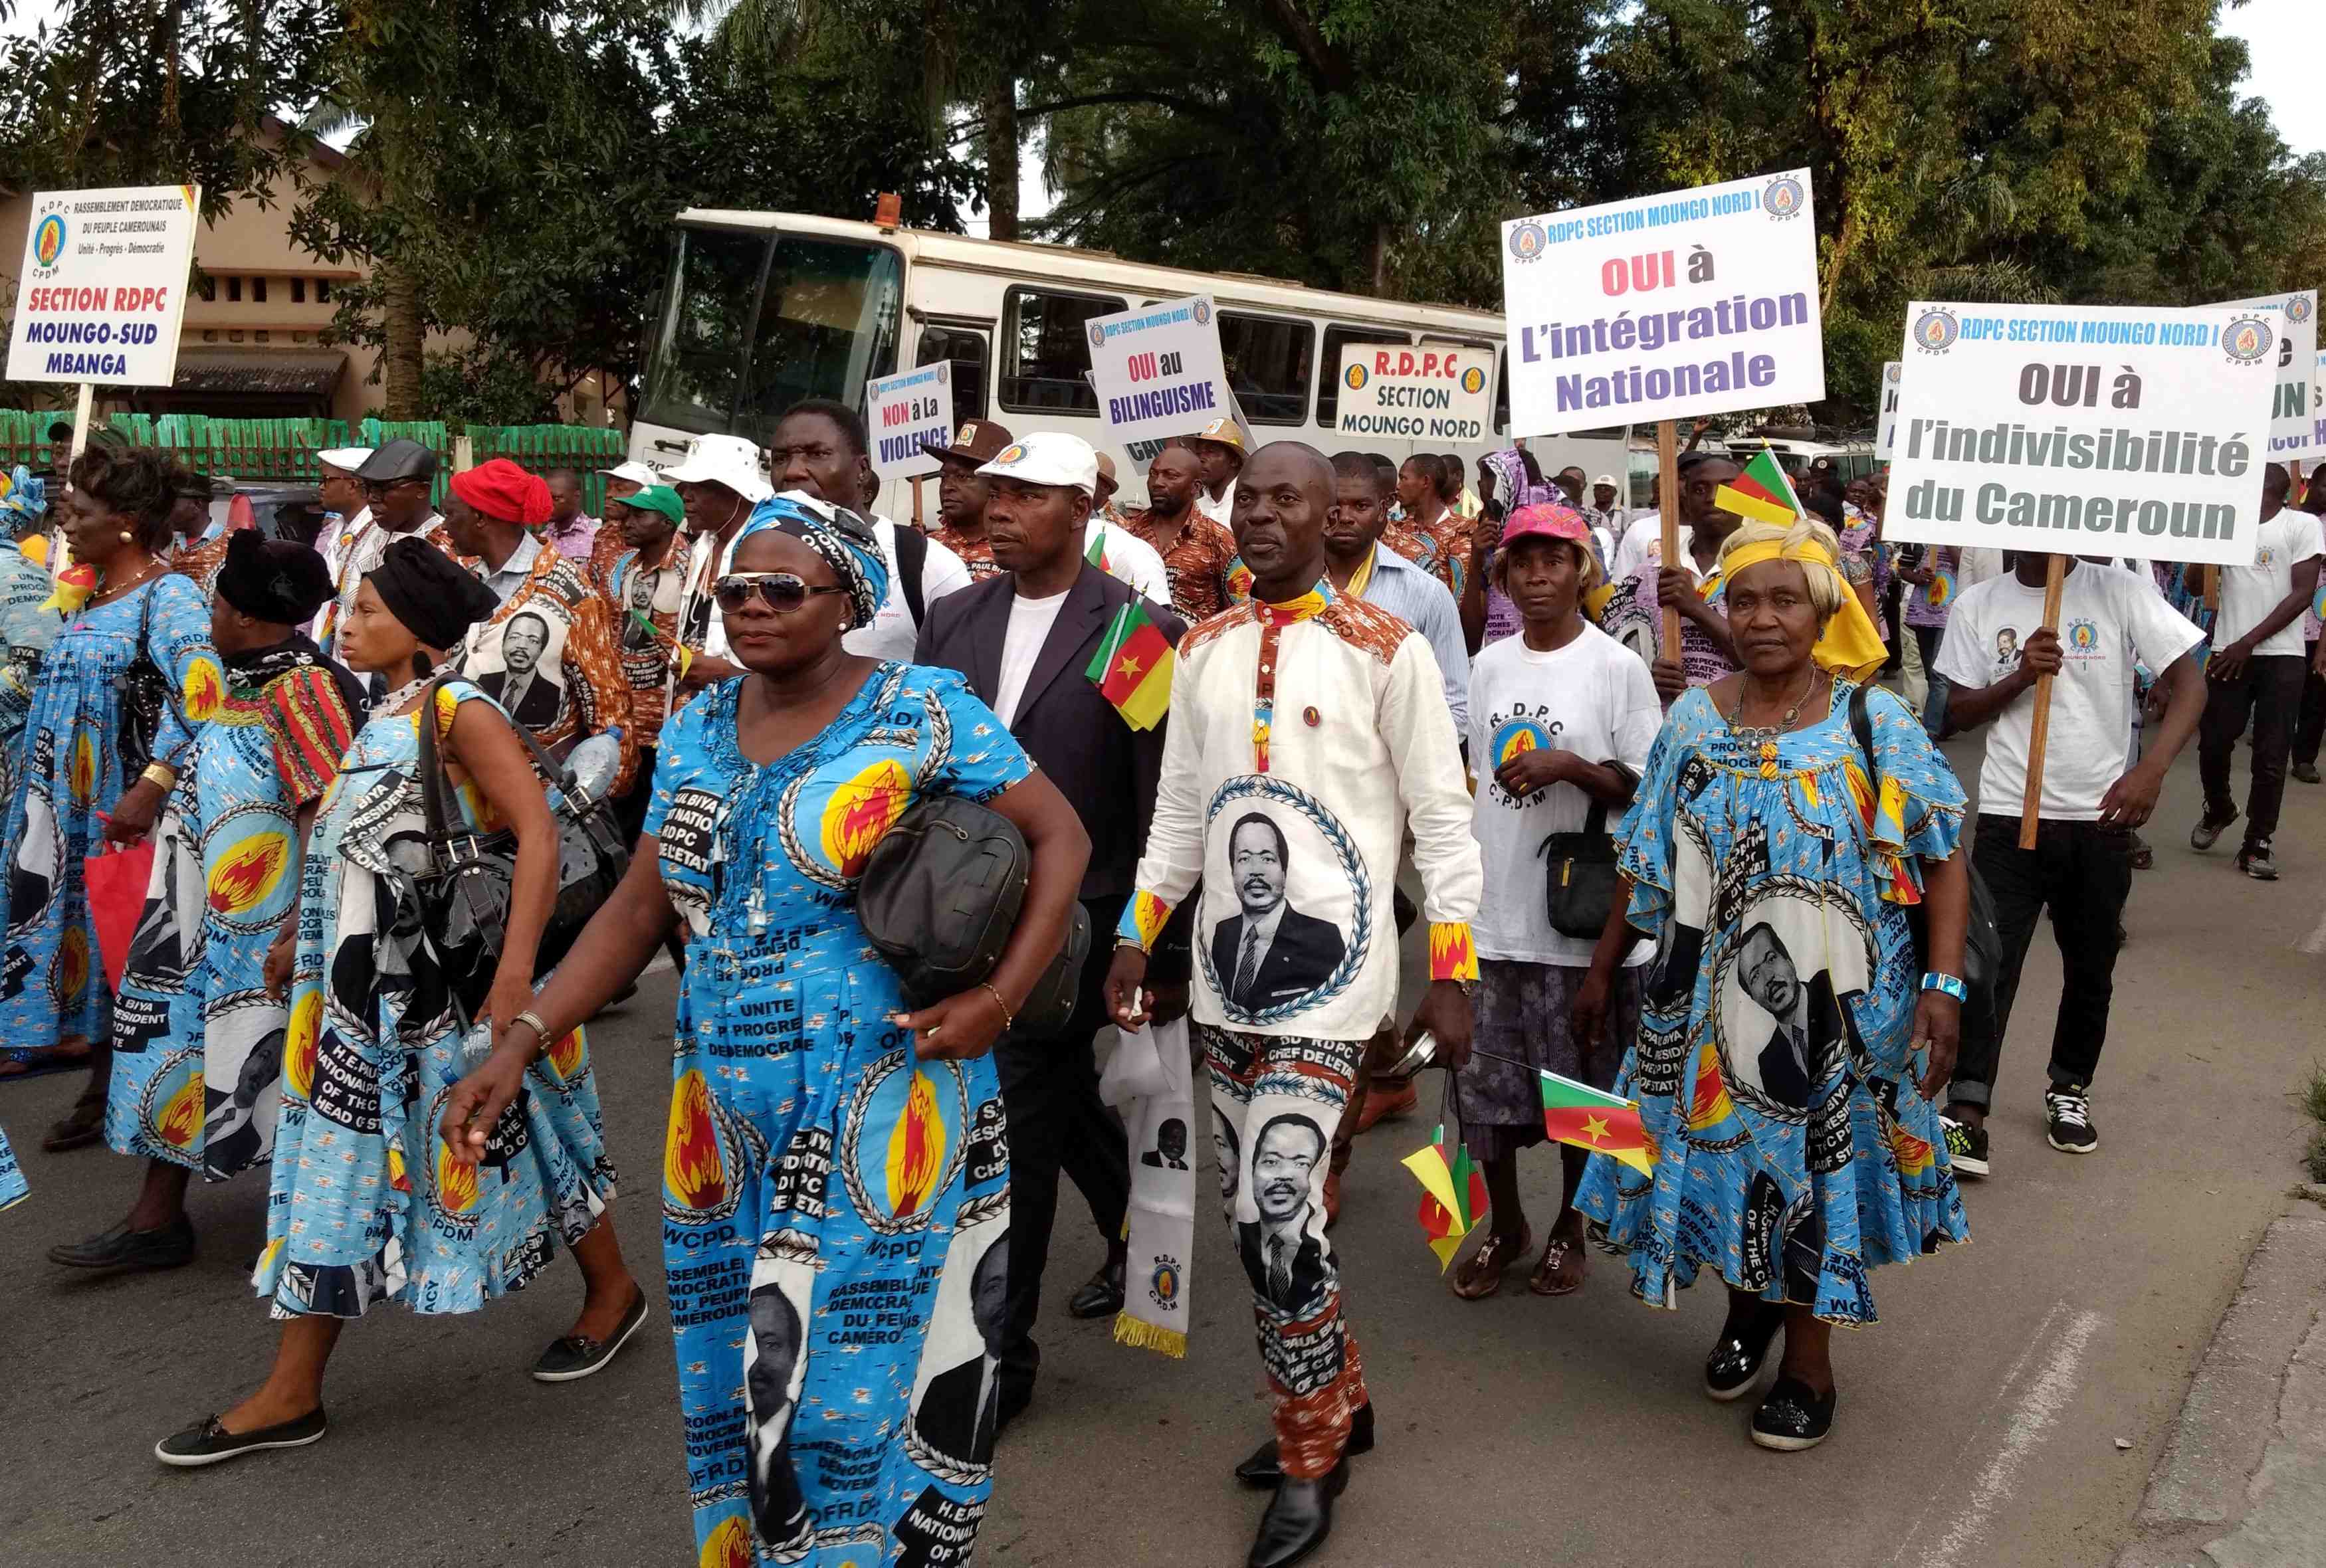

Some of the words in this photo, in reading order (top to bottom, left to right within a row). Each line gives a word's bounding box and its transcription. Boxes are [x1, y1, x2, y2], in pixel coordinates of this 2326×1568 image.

[74, 200, 129, 213] RASSEMBLEMENT
[130, 199, 183, 211] DEMOCRATIQUE
[1548, 220, 1584, 244] RDPC
[1588, 209, 1643, 238] SECTION
[1647, 198, 1708, 228] MOUNGO
[1713, 191, 1752, 216] NORD
[82, 223, 92, 234] DU
[93, 222, 118, 233] PEUPLE
[119, 221, 166, 233] CAMEROUNAIS
[1601, 250, 1675, 296] OUI
[1687, 244, 1715, 284] à
[29, 288, 108, 311] SECTION
[114, 286, 167, 312] RDPC
[27, 322, 157, 344] MOUNGO-SUD
[1121, 320, 1145, 334] SECTION
[1146, 314, 1172, 330] MOUNGO
[1172, 309, 1190, 324] NORD
[1522, 292, 1808, 363] L'intégration
[1960, 318, 2004, 342] RDPC
[2007, 319, 2077, 343] SECTION
[2081, 321, 2155, 345] MOUNGO
[2159, 322, 2209, 347] NORD
[46, 353, 126, 375] MBANGA
[1128, 351, 1158, 382] OUI
[1160, 351, 1183, 377] au
[1374, 351, 1457, 379] R.D.P.C
[1556, 351, 1776, 412] Nationale
[2018, 363, 2101, 408] OUI
[2111, 365, 2142, 409] à
[1109, 381, 1216, 424] BILINGUISME
[1377, 385, 1450, 409] SECTION
[883, 402, 909, 427] NON
[912, 399, 920, 421] à
[924, 397, 938, 419] La
[1342, 414, 1424, 436] MOUNGO
[1430, 419, 1481, 438] NORD
[879, 426, 948, 463] VIOLENCE
[1907, 418, 2250, 477] l'indivisibilité
[1905, 479, 1964, 522] du
[1976, 482, 2236, 541] Cameroun
[687, 794, 718, 813] BIYA
[740, 999, 795, 1017] UNITE
[1269, 1048, 1302, 1061] CHEF
[322, 1081, 343, 1098] OF
[315, 1095, 353, 1124] HEAD
[908, 1508, 973, 1543] NATIONAL
[930, 1544, 954, 1561] OF
